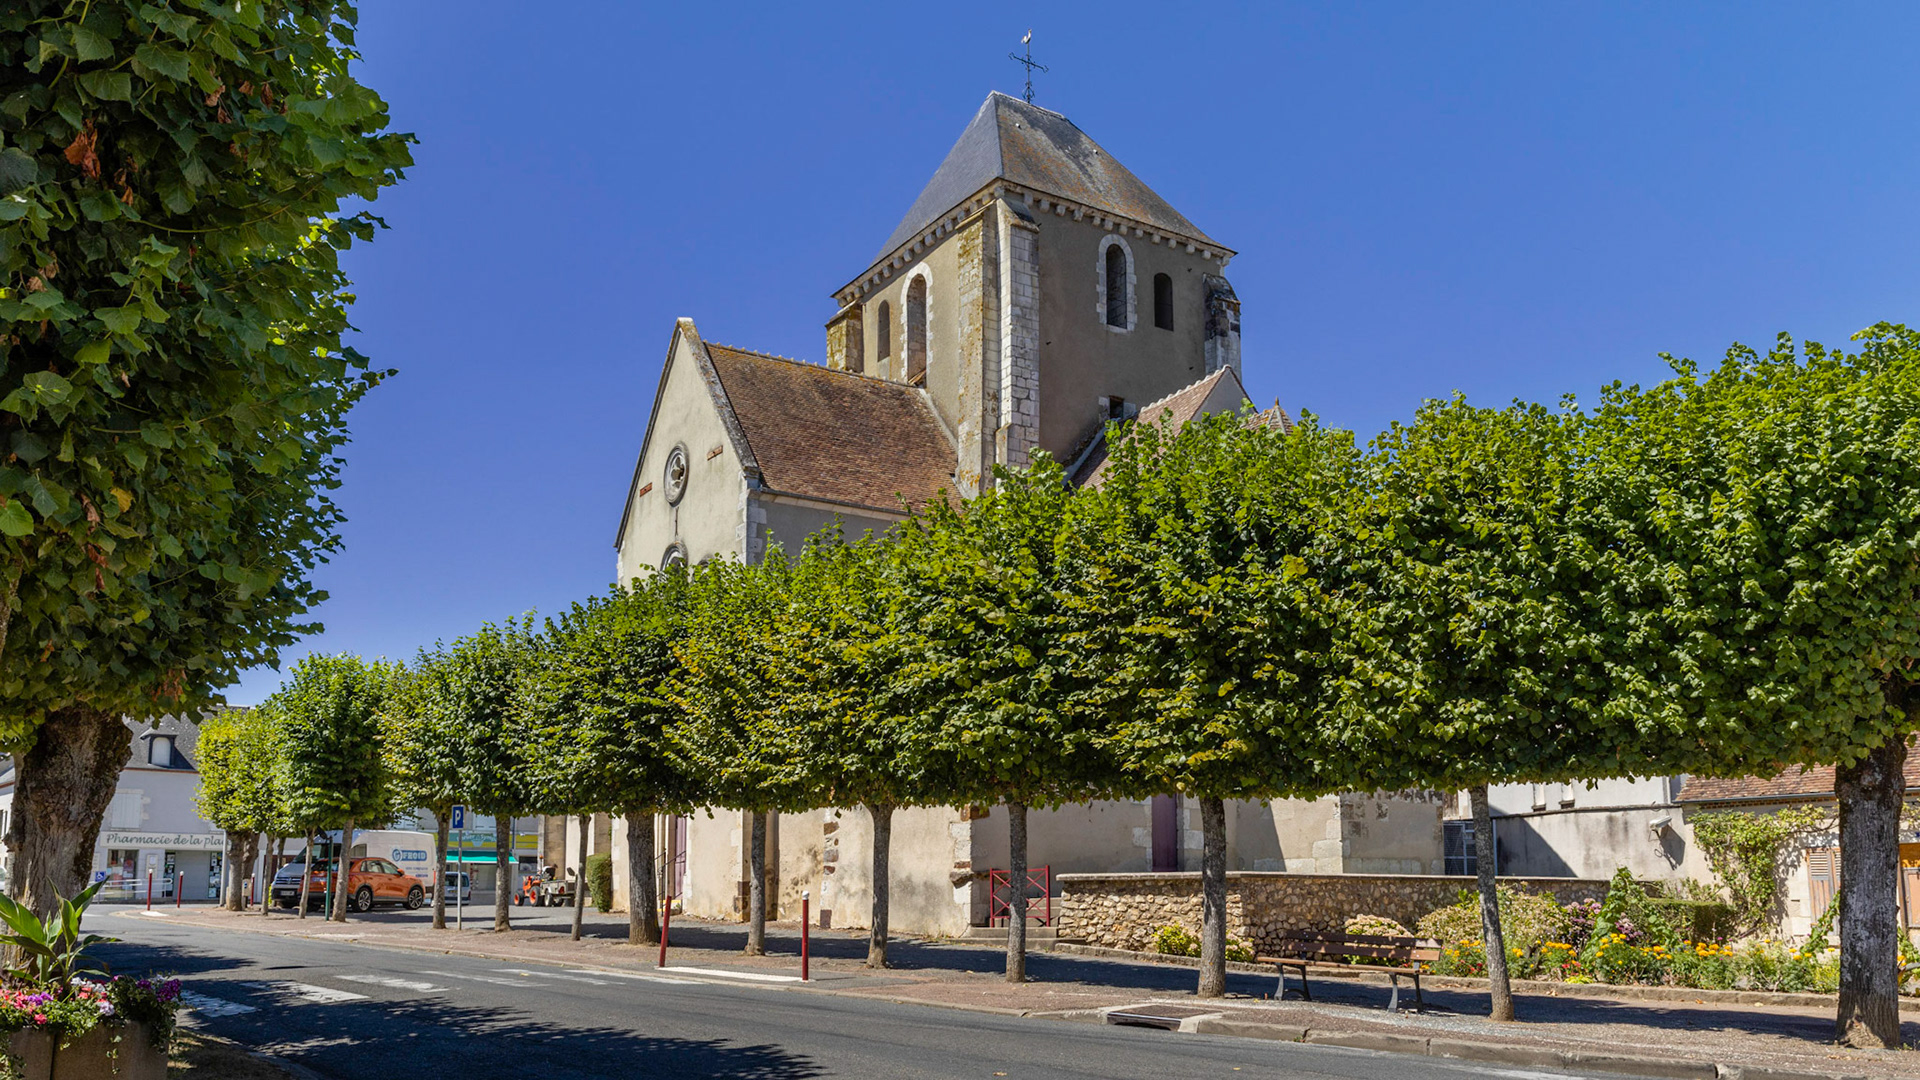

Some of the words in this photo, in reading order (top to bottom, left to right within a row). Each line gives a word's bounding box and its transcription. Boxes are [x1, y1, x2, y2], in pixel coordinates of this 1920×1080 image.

[455, 810, 461, 825] P
[106, 833, 173, 844] Pharmacie
[173, 835, 189, 845] de
[189, 835, 203, 845] la
